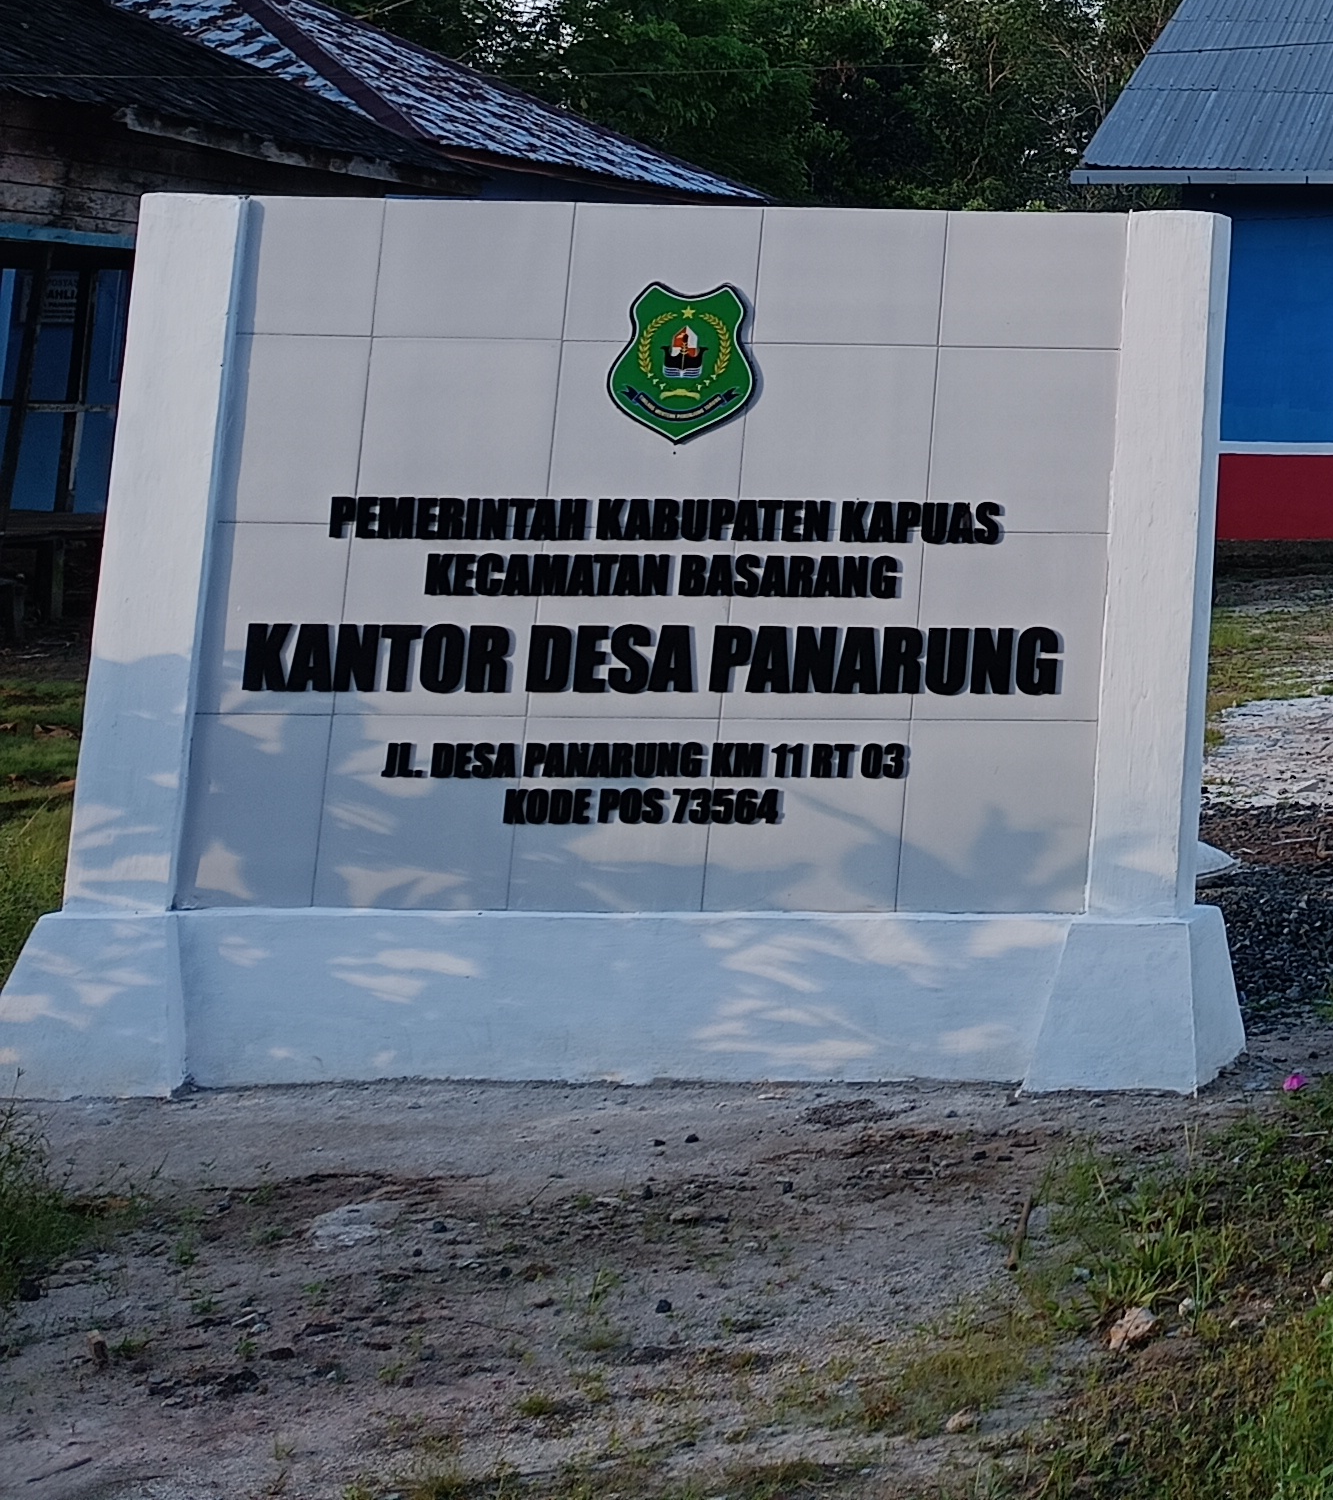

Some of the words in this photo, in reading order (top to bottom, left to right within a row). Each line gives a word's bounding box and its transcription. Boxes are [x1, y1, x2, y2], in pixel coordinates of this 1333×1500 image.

[329, 496, 592, 542] PEMERINTAH
[596, 498, 832, 543] KABUPATEN
[839, 500, 1004, 545] KAPUAS
[424, 552, 672, 597] KECAMATAN
[678, 553, 899, 600] BASARANG
[242, 622, 511, 694] KANTOR
[526, 624, 694, 695] DESA
[709, 625, 1059, 696] PANARUNG
[381, 742, 424, 779] JL.
[429, 742, 517, 780] DESA
[523, 742, 705, 779] PANARUNG
[710, 742, 766, 778] KM
[772, 743, 805, 779] 11
[810, 743, 857, 779] RT
[860, 742, 906, 780] 03
[503, 788, 593, 826] KODE
[598, 787, 667, 825] POS
[672, 787, 780, 825] 73564
